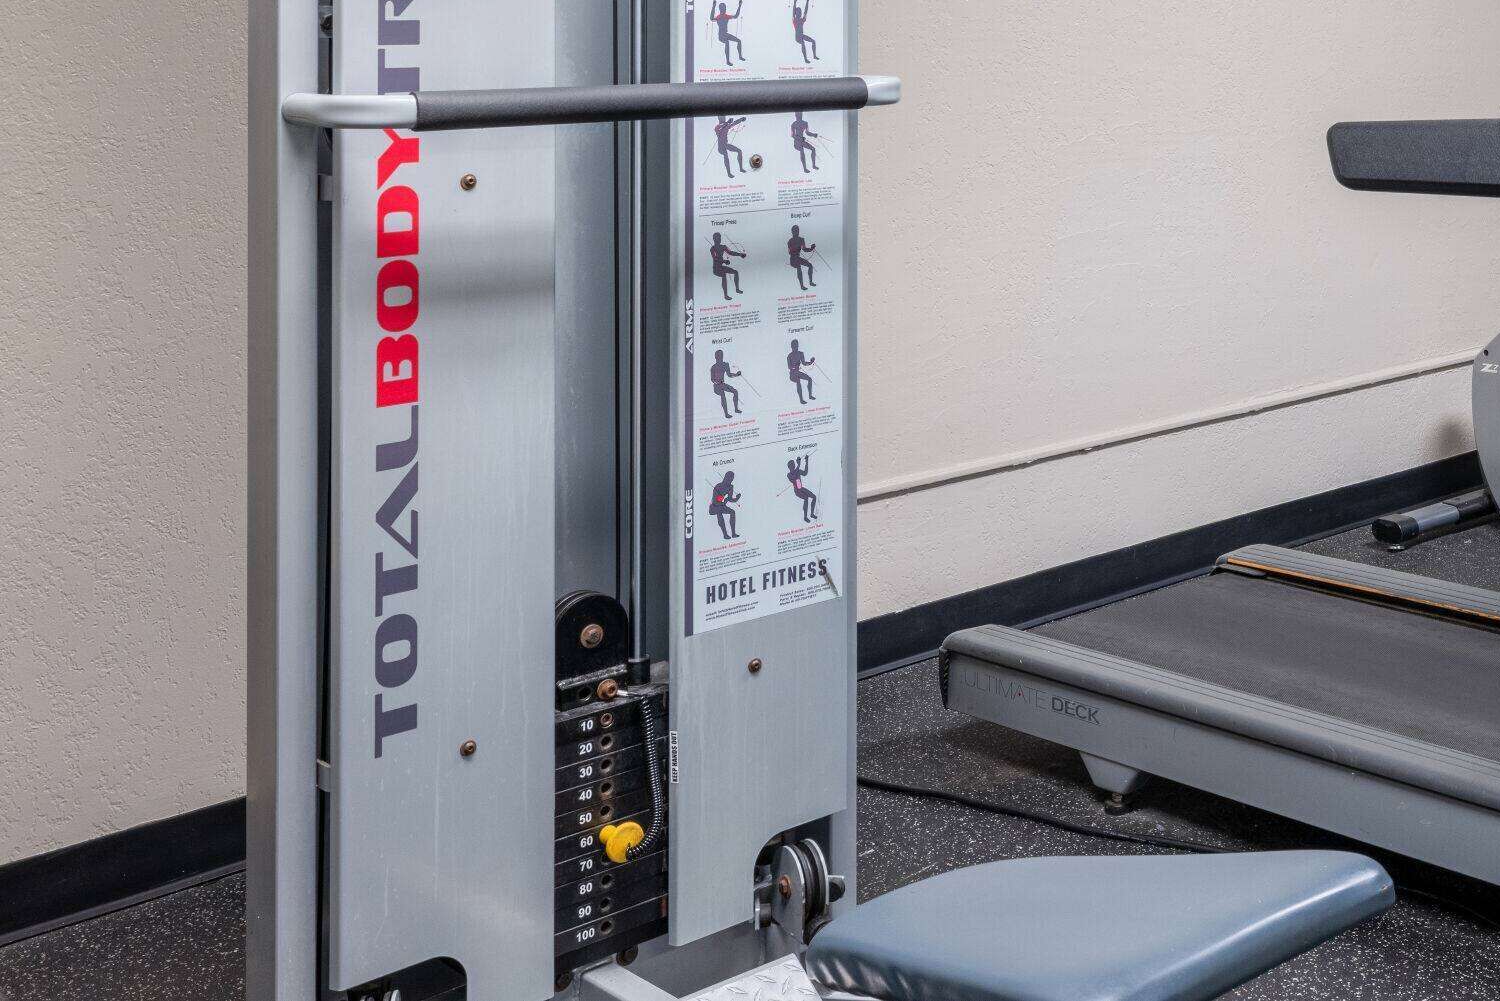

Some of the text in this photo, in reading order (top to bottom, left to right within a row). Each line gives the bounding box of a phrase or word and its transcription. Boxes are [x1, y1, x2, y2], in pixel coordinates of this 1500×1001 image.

[685, 298, 694, 355] ARMS
[685, 488, 693, 539] CORE
[706, 576, 757, 605] HOTEL
[762, 558, 827, 591] FITNESS
[965, 672, 1101, 726] ULTIMATE DECK
[581, 720, 593, 732] 10
[580, 743, 592, 755] 20
[580, 766, 592, 778] 30
[579, 789, 592, 801] 40
[580, 812, 592, 824] 50
[580, 836, 593, 848] 60
[580, 860, 593, 871] 70
[580, 882, 593, 895] 80
[579, 905, 592, 918] 90
[577, 927, 595, 942] 100
